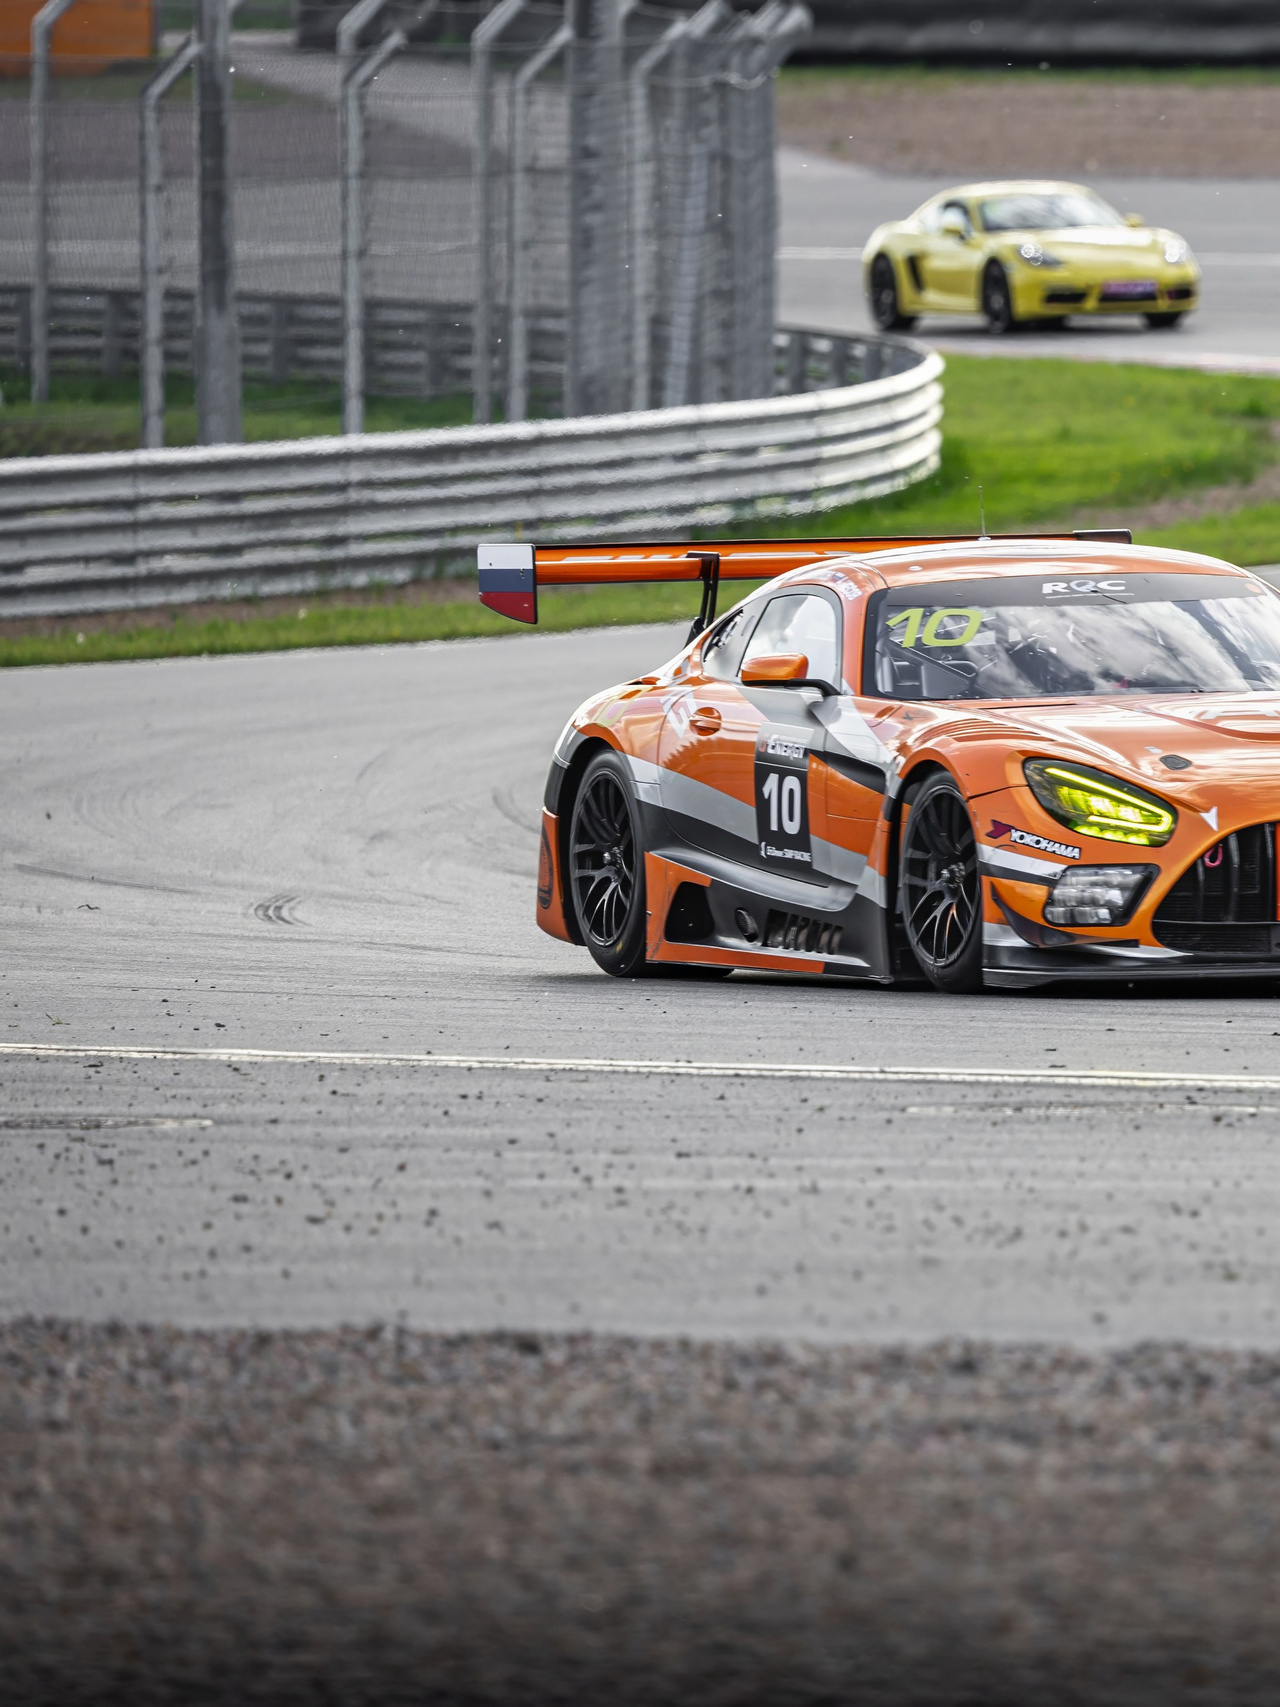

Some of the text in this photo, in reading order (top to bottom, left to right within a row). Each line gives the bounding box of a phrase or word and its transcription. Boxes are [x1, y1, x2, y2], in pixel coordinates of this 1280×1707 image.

[885, 608, 982, 647] 10
[762, 772, 802, 835] 10
[1010, 828, 1081, 860] YOKOHAMA
